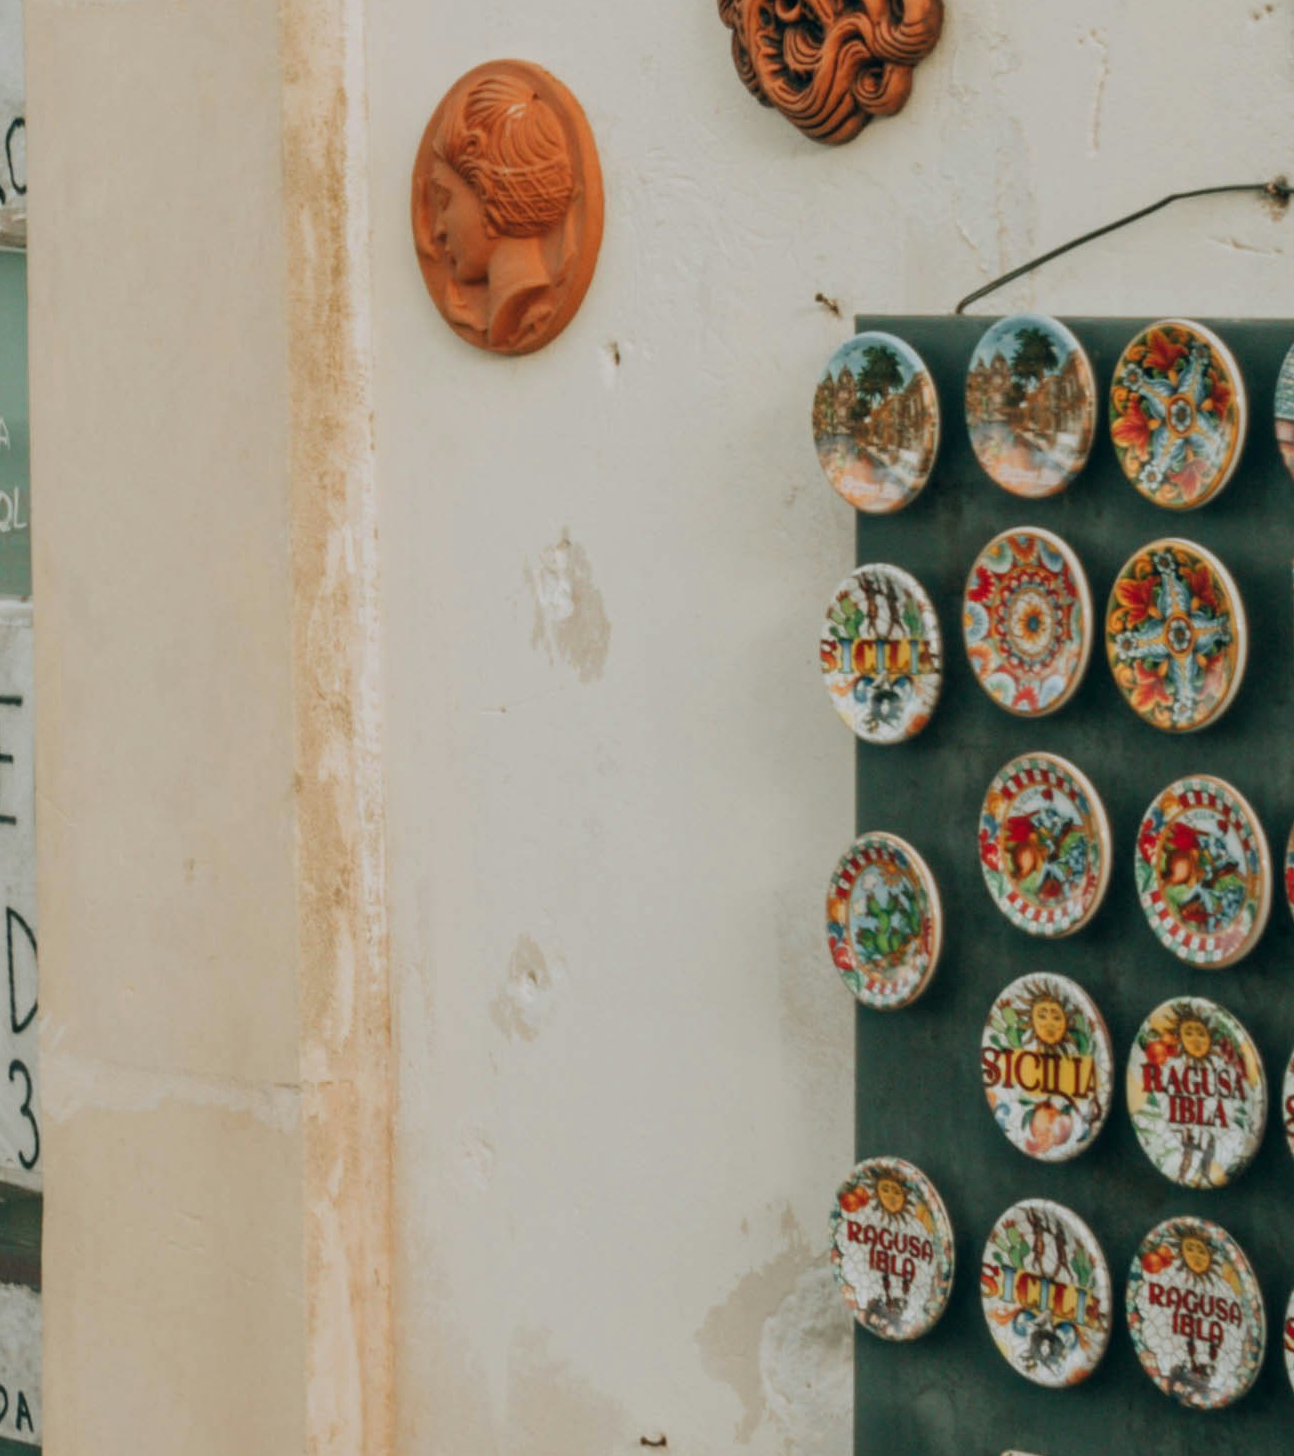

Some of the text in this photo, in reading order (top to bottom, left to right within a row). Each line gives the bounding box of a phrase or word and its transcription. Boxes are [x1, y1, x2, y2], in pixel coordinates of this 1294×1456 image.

[981, 1046, 1099, 1103] SICILIA
[1141, 1063, 1248, 1102] RAGUSA
[1169, 1095, 1228, 1128] IBLA
[847, 1220, 934, 1265] RAGUSA
[869, 1248, 917, 1283] IBLA
[1148, 1282, 1243, 1329] RAGUSA
[1172, 1312, 1225, 1350] IBLA
